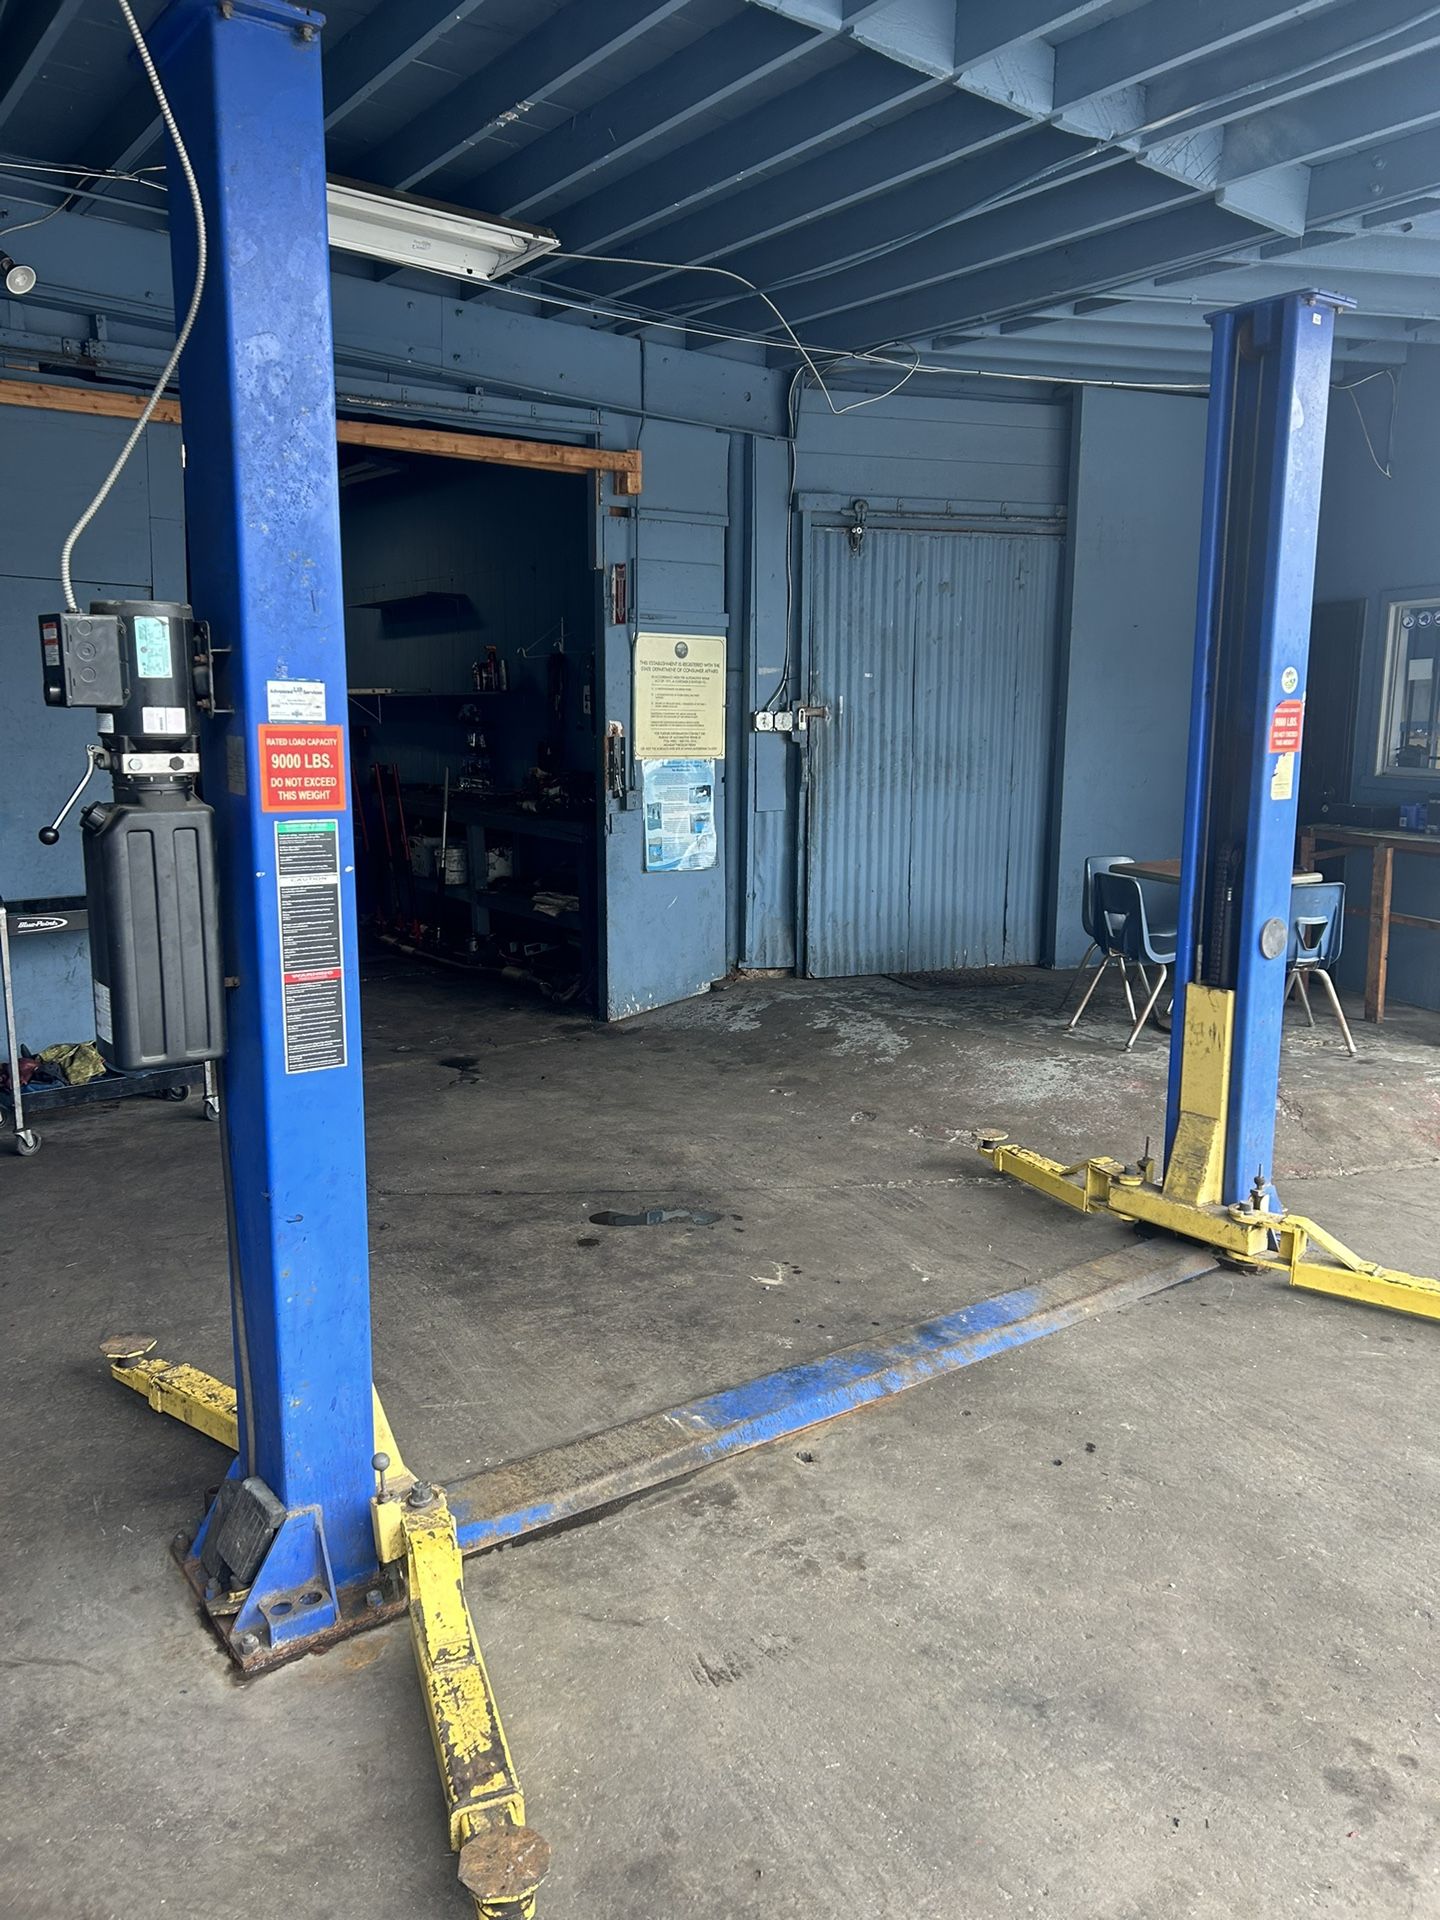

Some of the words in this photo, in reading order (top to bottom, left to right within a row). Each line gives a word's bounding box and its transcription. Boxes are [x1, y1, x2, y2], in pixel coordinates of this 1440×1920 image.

[266, 738, 288, 746] RATED
[288, 738, 307, 746] LOAD
[307, 738, 337, 746] CAPACITY
[271, 753, 301, 769] 9000
[304, 753, 334, 768] LBS.
[270, 777, 284, 787] DO
[285, 777, 303, 787] NOT
[304, 777, 337, 787] EXCEED
[278, 790, 297, 800] THIS
[298, 790, 331, 800] WEIGHT
